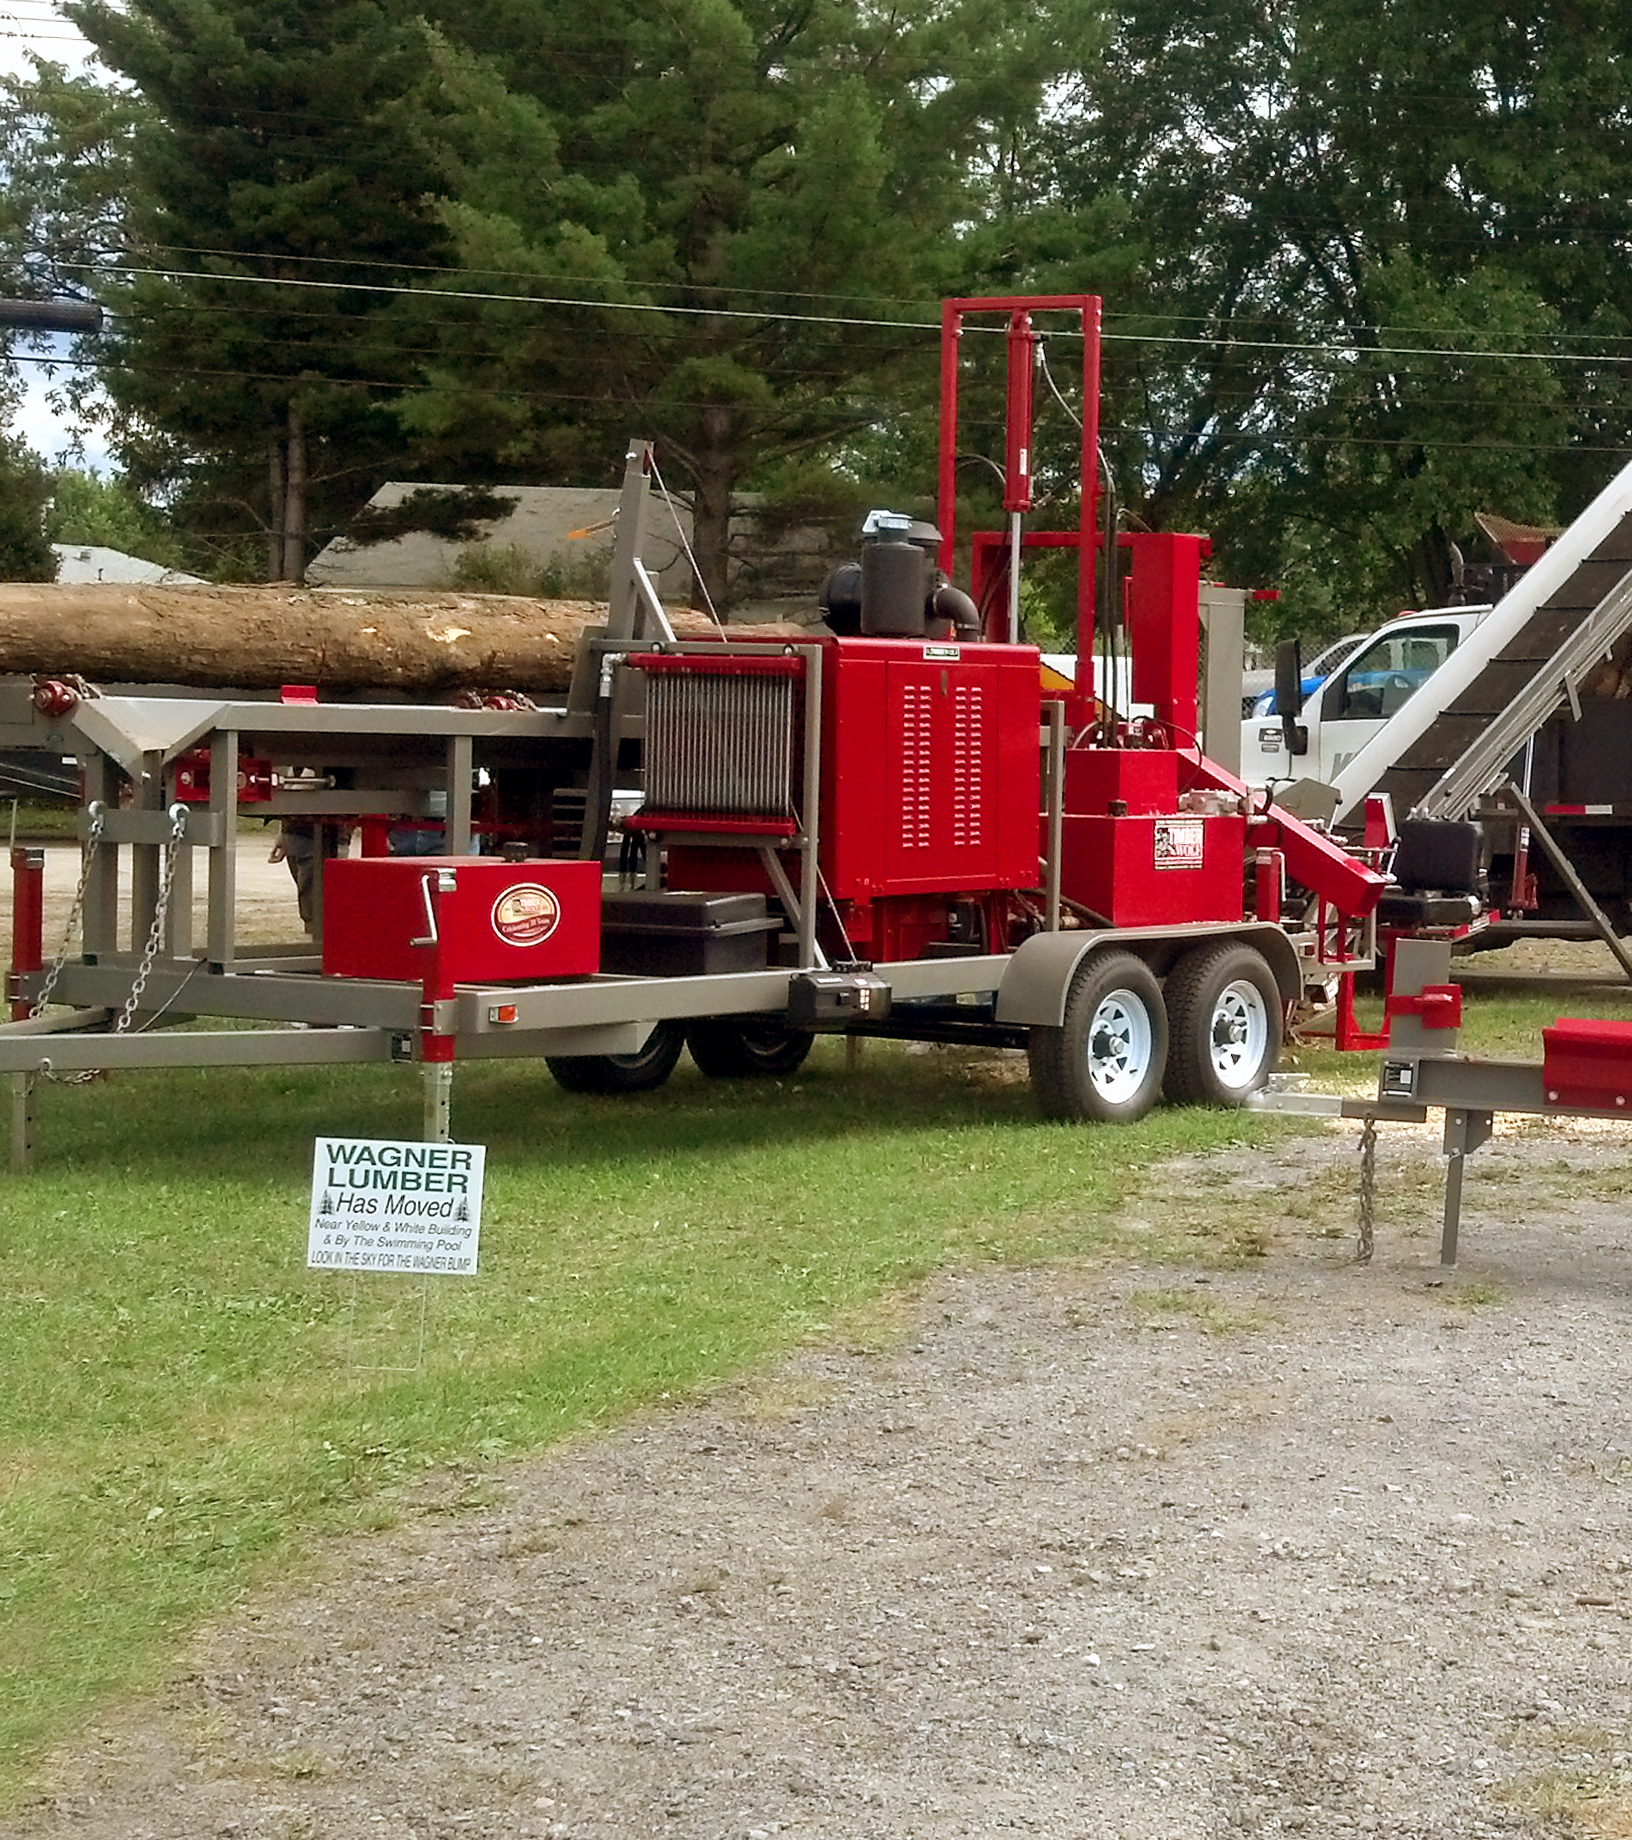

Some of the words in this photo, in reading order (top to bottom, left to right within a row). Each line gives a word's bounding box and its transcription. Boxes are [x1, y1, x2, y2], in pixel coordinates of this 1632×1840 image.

[326, 1144, 473, 1170] WAGNER
[328, 1167, 469, 1194] LUMBER
[336, 1192, 378, 1214] Has
[384, 1194, 455, 1218] Moved
[315, 1218, 342, 1230] Near
[346, 1220, 380, 1233] Yellow
[383, 1222, 390, 1232] &
[394, 1222, 425, 1235] White
[428, 1223, 472, 1239] Building
[323, 1235, 332, 1245] &
[335, 1234, 350, 1248] By
[354, 1236, 374, 1247] The
[377, 1237, 433, 1251] Swimming
[436, 1239, 462, 1251] Pool
[312, 1250, 333, 1264] LOOK
[335, 1252, 343, 1264] IN
[345, 1252, 360, 1265] THE
[361, 1253, 376, 1265] SKY
[377, 1253, 394, 1266] FOR
[396, 1254, 411, 1267] THE
[413, 1255, 447, 1270] WAGNER
